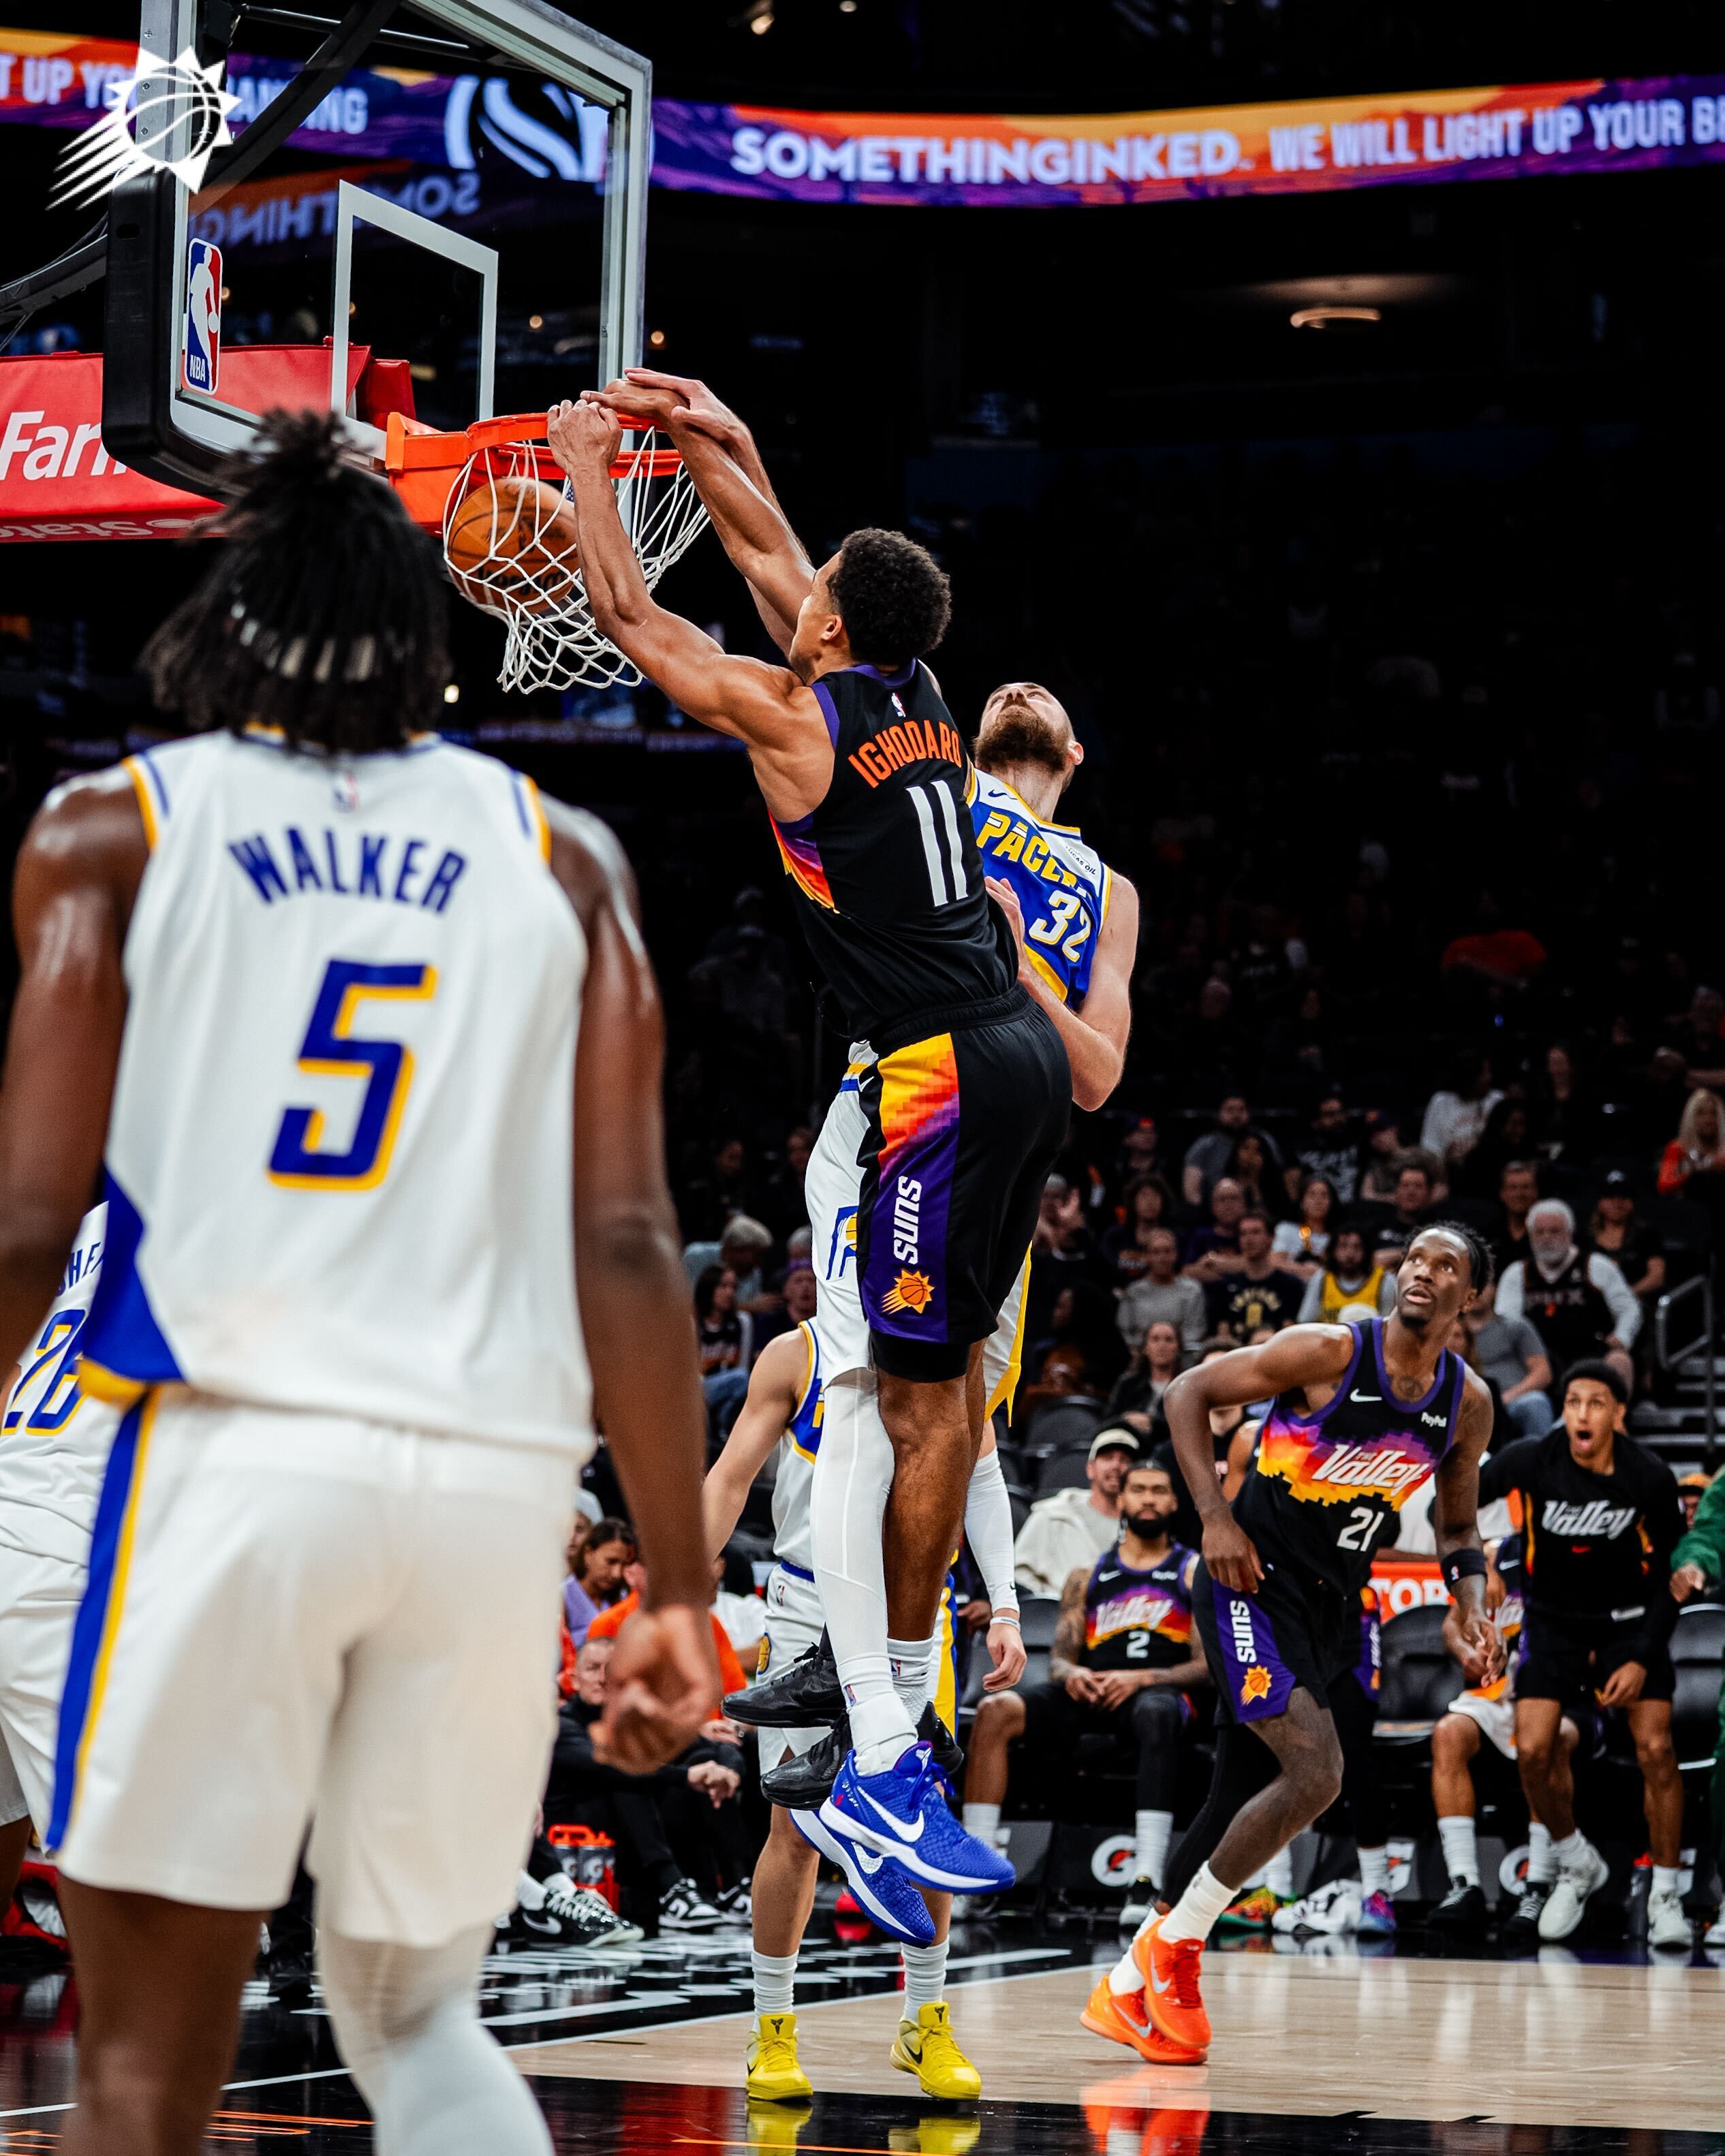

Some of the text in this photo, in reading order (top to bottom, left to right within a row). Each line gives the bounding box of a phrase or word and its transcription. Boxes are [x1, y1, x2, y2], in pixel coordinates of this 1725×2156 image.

[22, 57, 73, 106] UP
[1269, 123, 1325, 173] WE
[1330, 116, 1417, 168] WILL
[1424, 109, 1527, 161] LIGHT
[1532, 105, 1583, 155] UP
[1588, 98, 1685, 151] YOUR
[189, 354, 206, 382] NBA
[848, 719, 962, 789] IGHODARO
[228, 824, 468, 913] WALKER
[905, 779, 969, 907] 11
[1029, 888, 1091, 963] 32
[265, 957, 439, 1191] 5
[1421, 1411, 1447, 1427] PayPal
[1311, 1444, 1430, 1497] Valley
[1337, 1506, 1384, 1552] 21
[1541, 1500, 1636, 1540] Valley
[1126, 1630, 1150, 1658] 2
